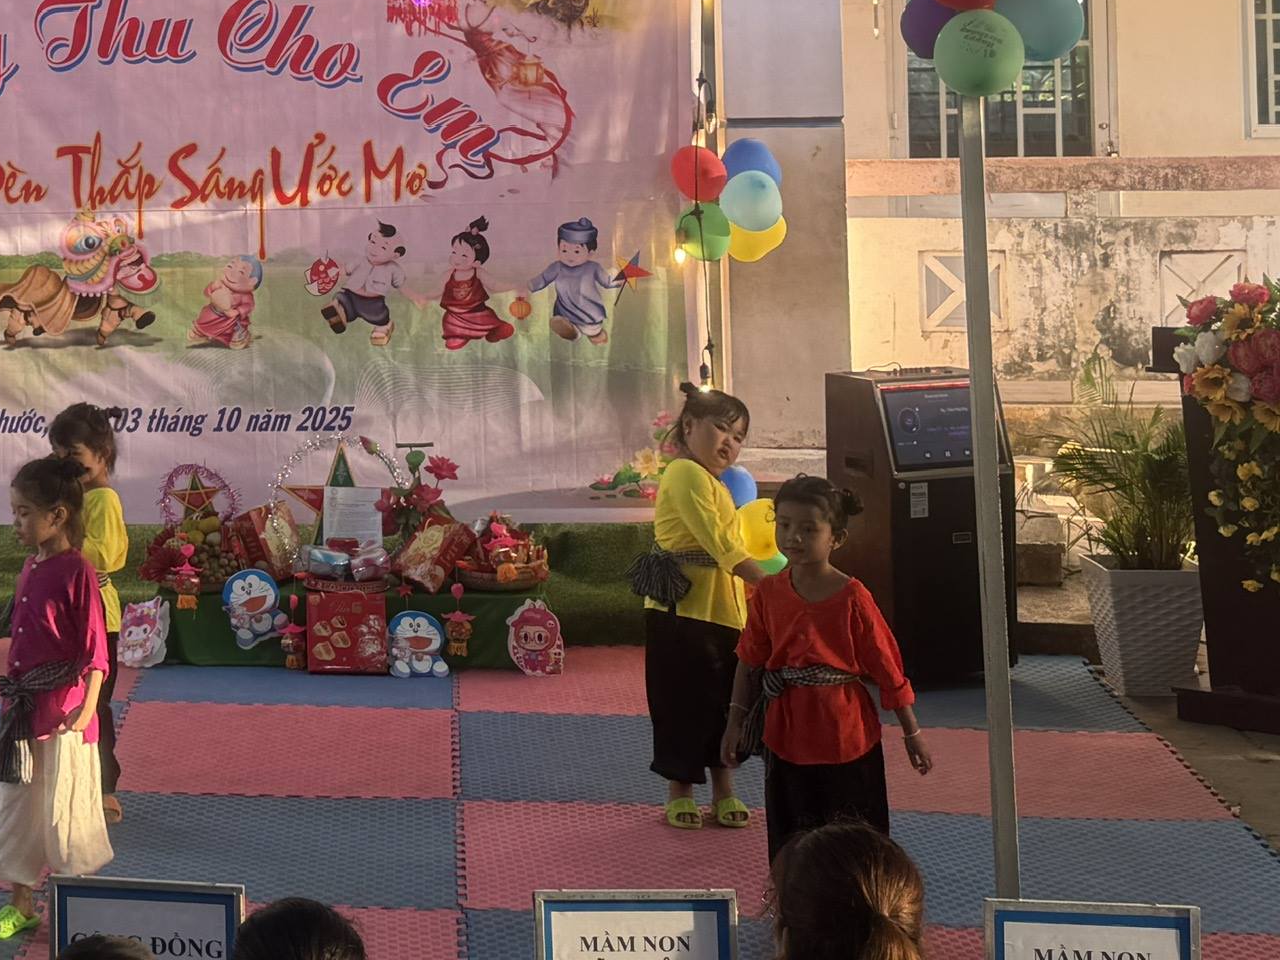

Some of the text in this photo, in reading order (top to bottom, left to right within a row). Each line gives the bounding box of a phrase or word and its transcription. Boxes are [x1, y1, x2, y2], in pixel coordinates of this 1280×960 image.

[376, 50, 500, 169] Em
[56, 130, 160, 240] Thắp
[168, 142, 266, 261] Sáng
[271, 132, 354, 208] Ước
[363, 140, 427, 203] Mơ
[146, 407, 208, 437] tháng
[212, 406, 242, 433] 10
[245, 408, 292, 433] năm
[295, 406, 355, 432] 2025
[643, 936, 690, 952] NON
